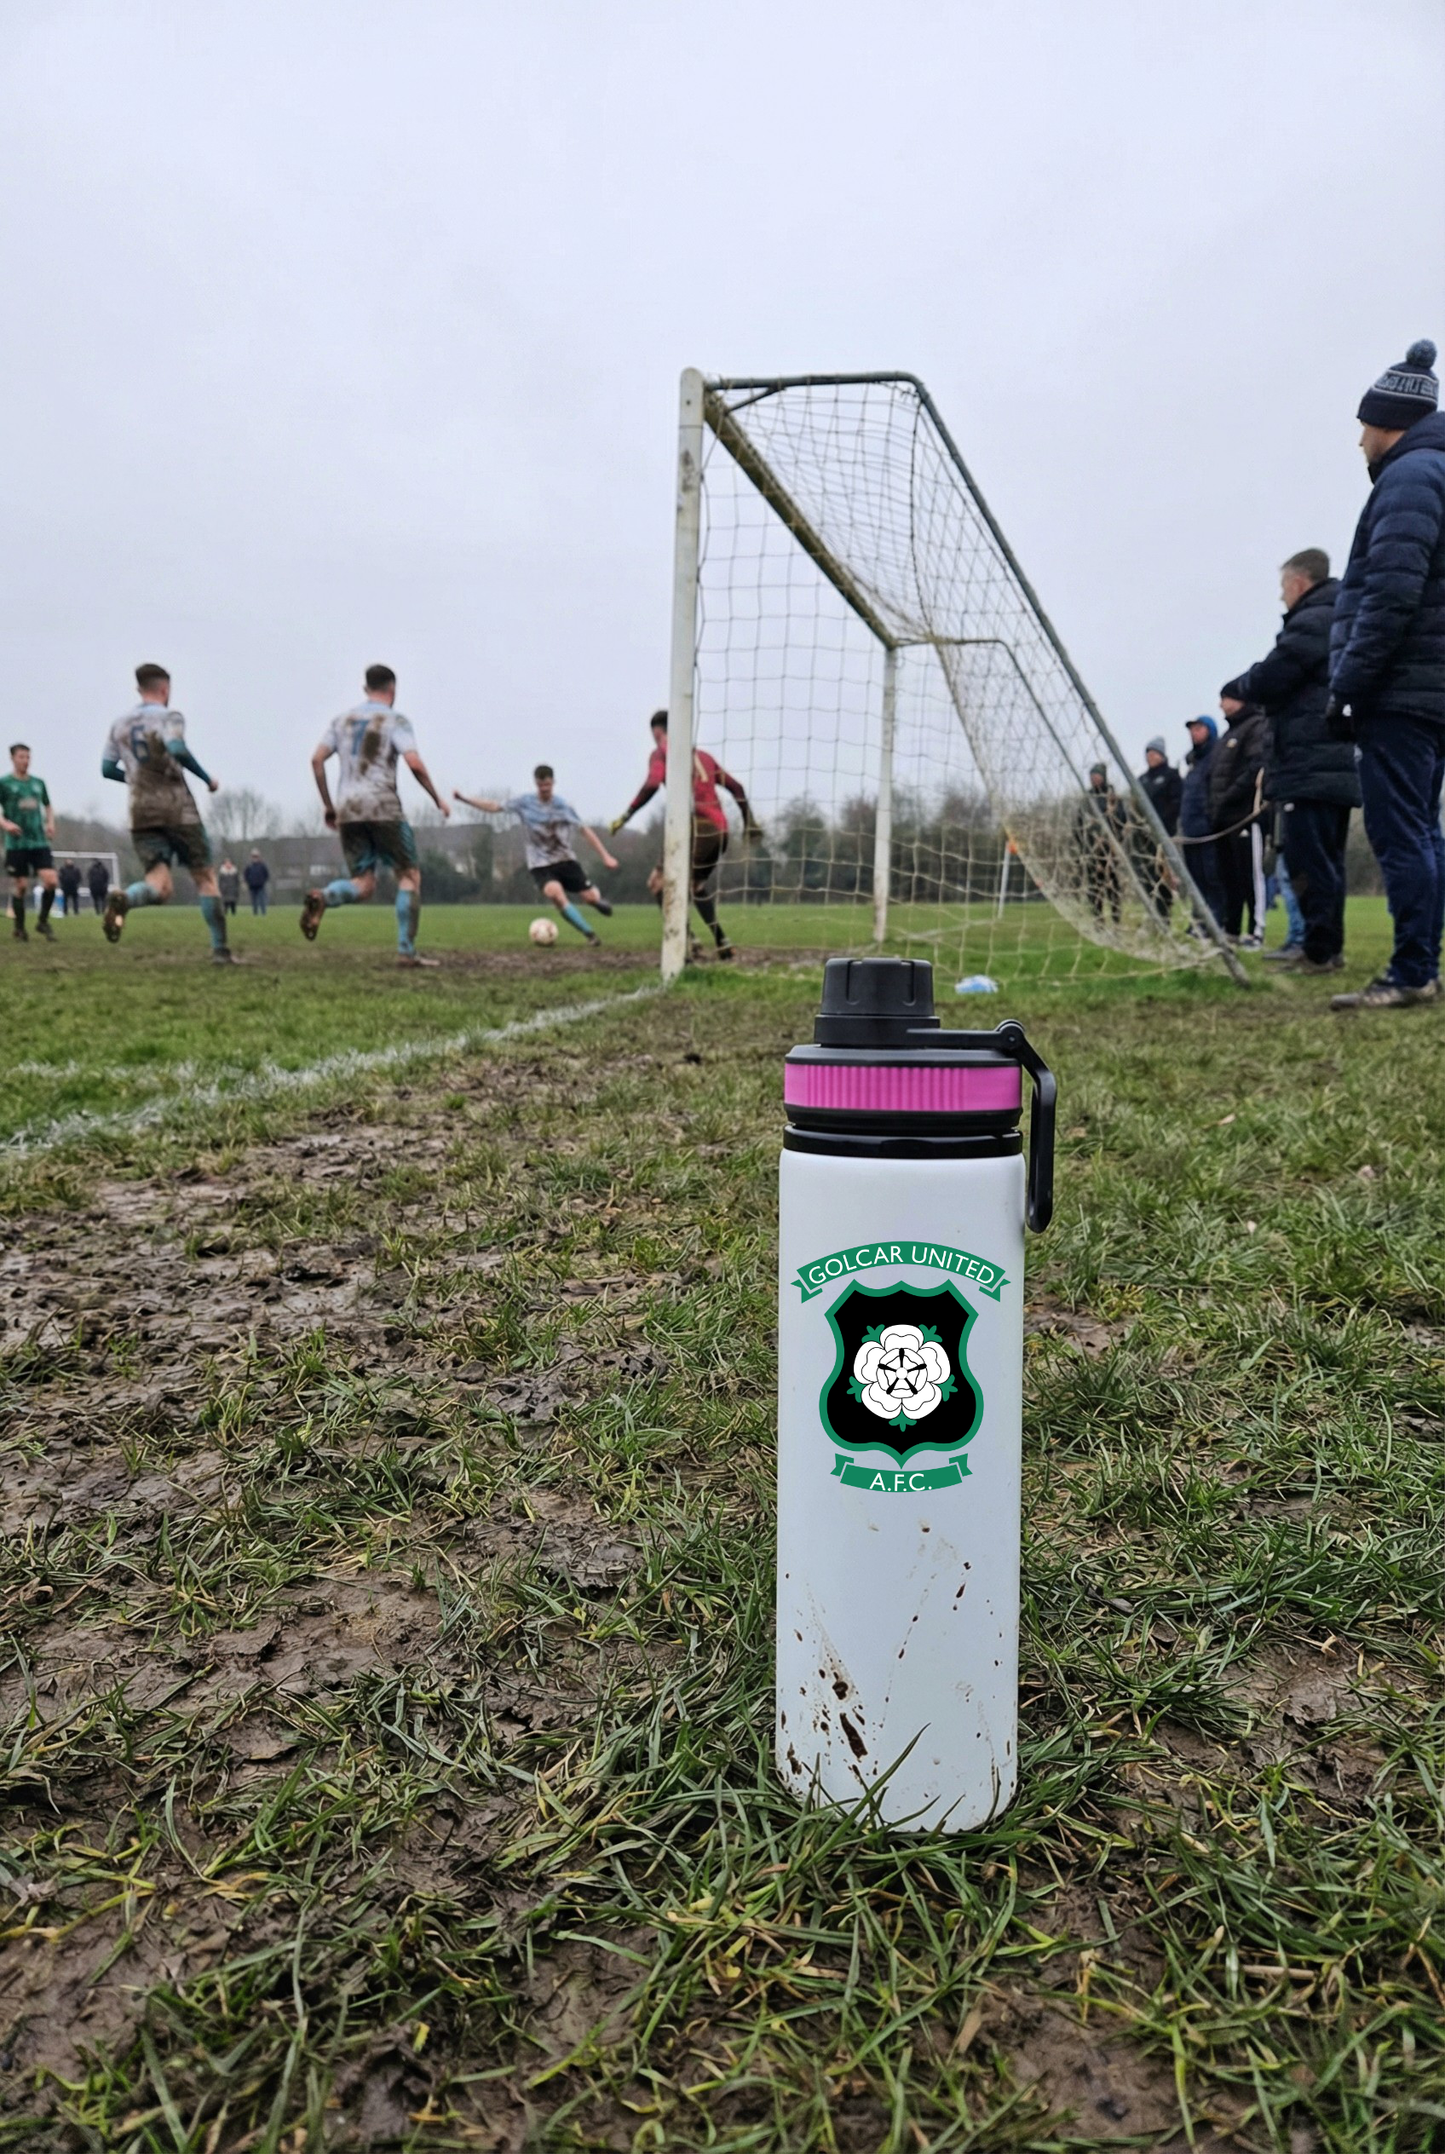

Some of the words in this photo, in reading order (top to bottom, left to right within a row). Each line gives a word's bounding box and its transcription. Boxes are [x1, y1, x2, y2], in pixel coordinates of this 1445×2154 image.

[130, 724, 150, 763] 6
[808, 1245, 904, 1284] GOLCAR
[911, 1245, 995, 1284] UNITED
[869, 1472, 933, 1492] A.F.C.
